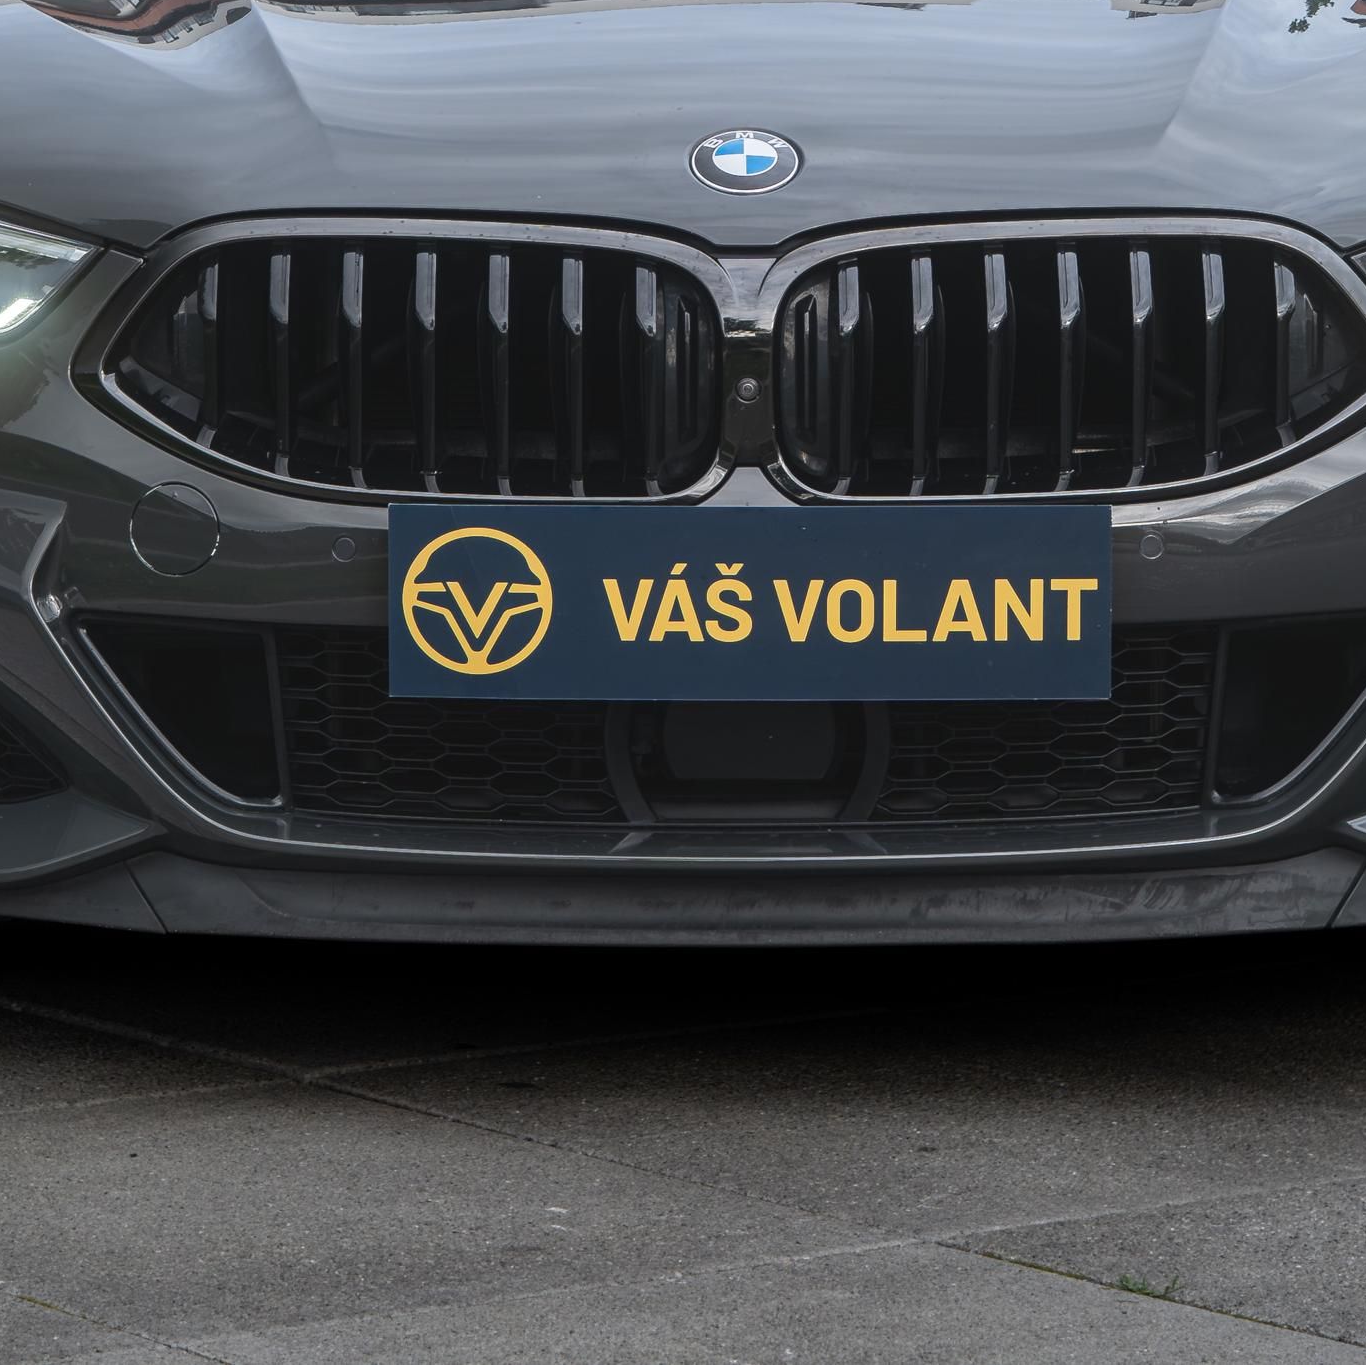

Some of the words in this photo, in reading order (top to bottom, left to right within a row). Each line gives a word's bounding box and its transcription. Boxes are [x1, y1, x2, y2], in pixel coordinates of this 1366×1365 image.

[704, 132, 788, 148] BMW
[603, 562, 753, 643] VÁŠ
[774, 578, 1099, 643] VOLANT
